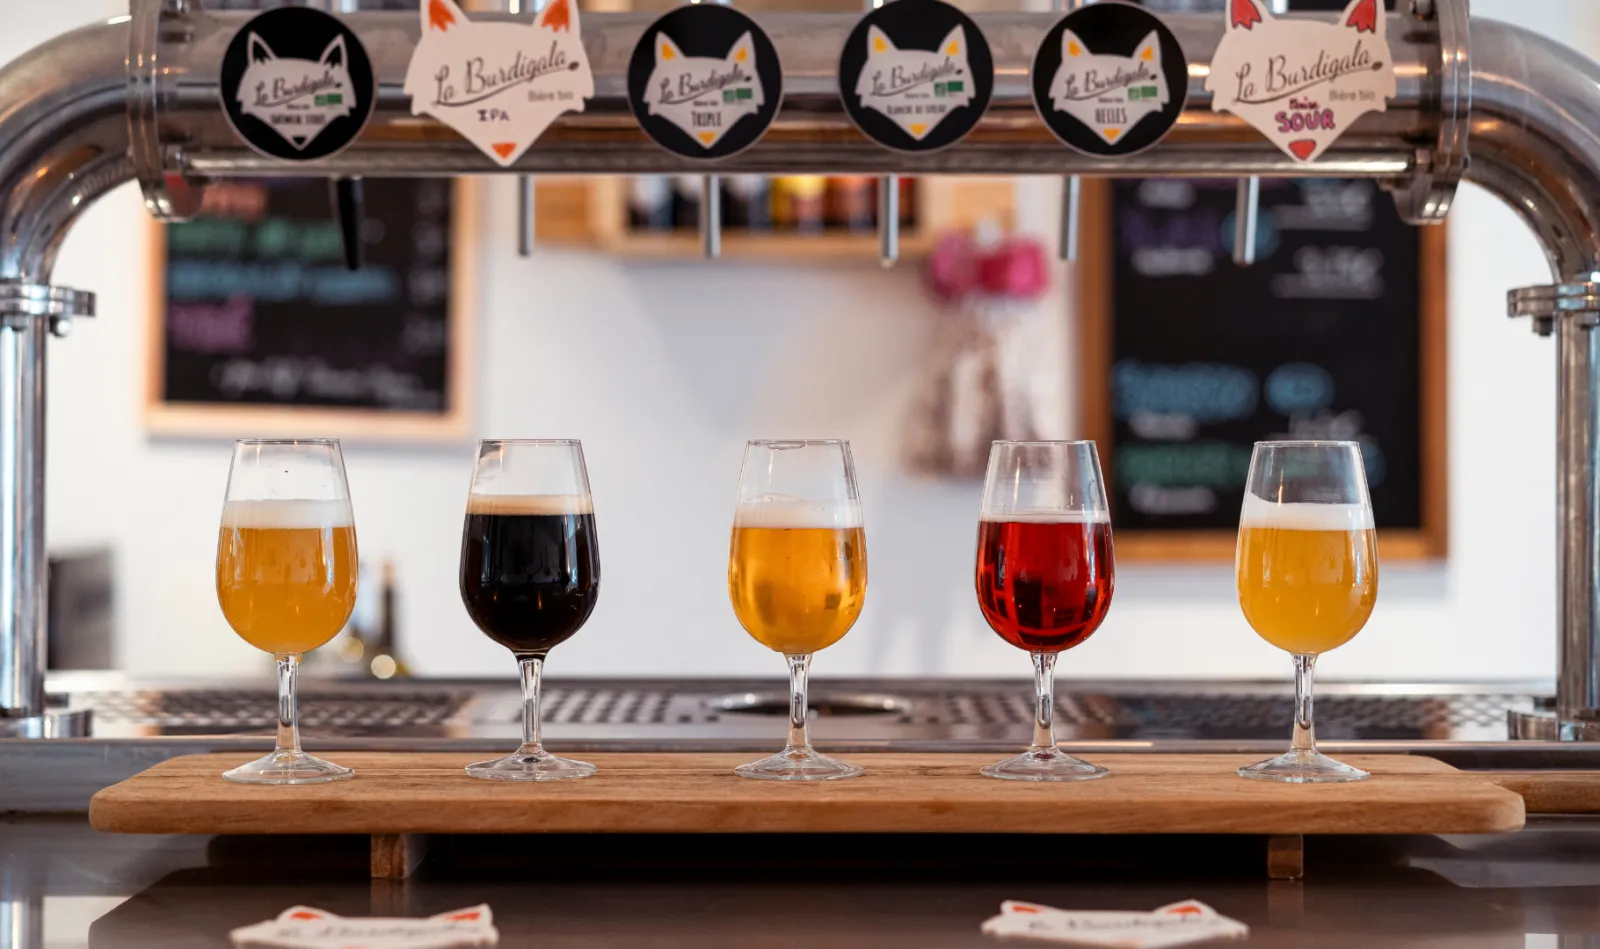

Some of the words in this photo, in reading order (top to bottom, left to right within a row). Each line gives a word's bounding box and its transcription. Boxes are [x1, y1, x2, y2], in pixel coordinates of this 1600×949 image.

[254, 80, 269, 106] La
[273, 70, 334, 99] Burdigala
[431, 64, 455, 107] La
[465, 40, 567, 94] Burdigala
[658, 77, 673, 104] La
[678, 63, 743, 96] Burdigala
[870, 70, 885, 96] La
[891, 56, 955, 89] Burdigala
[1063, 73, 1079, 99] La
[1084, 61, 1149, 92] Burdigala
[1234, 62, 1256, 104] La
[1265, 39, 1370, 93] Burdigala
[1329, 88, 1357, 101] Bière
[1359, 88, 1376, 100] bio
[477, 108, 510, 122] IPA
[1275, 108, 1335, 133] SOUR
